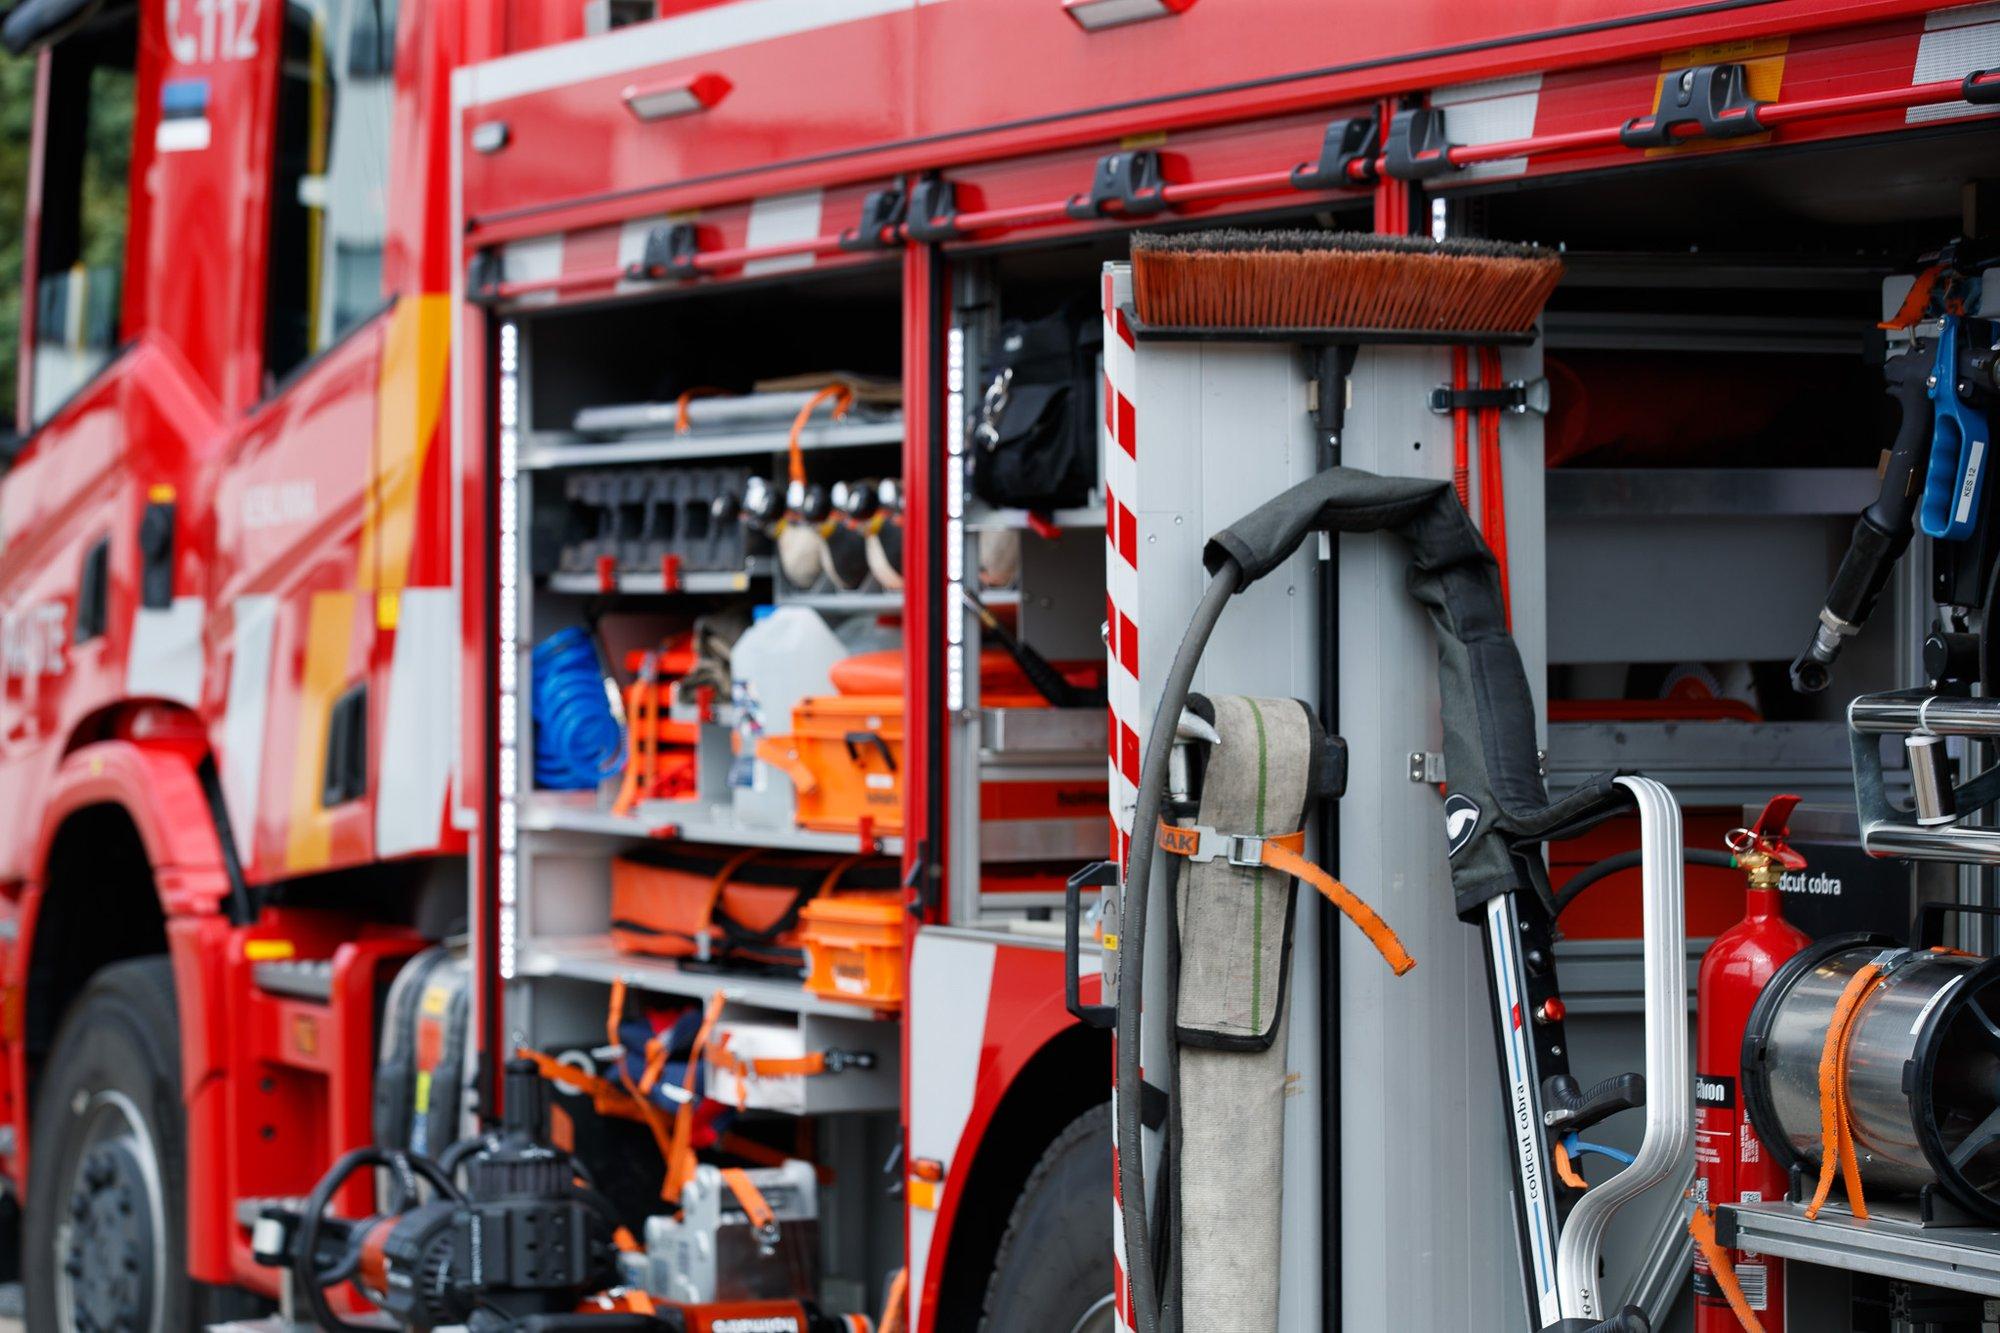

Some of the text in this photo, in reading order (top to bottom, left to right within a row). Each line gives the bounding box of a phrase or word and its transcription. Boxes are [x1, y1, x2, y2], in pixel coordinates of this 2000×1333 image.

[1967, 466, 1977, 478] 12
[1808, 871, 1842, 896] cobra
[1516, 1084, 1539, 1200] coldcut cobra
